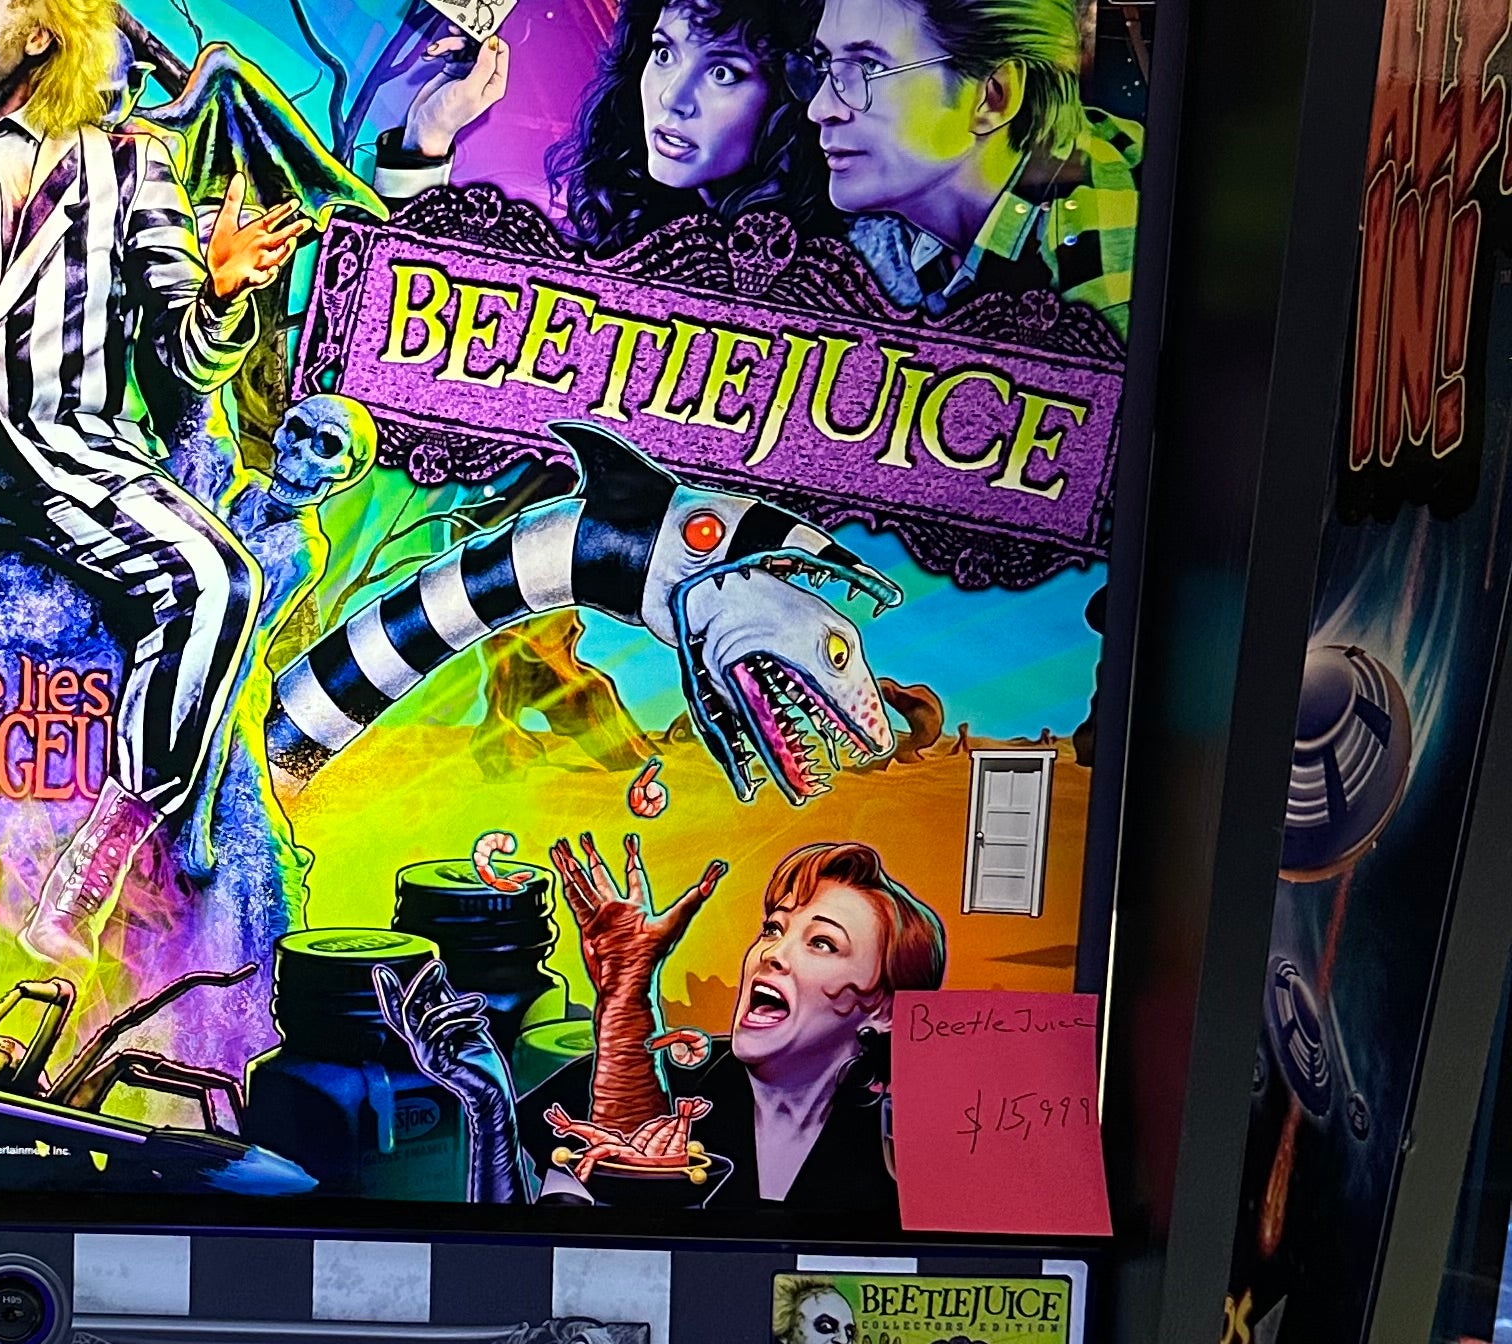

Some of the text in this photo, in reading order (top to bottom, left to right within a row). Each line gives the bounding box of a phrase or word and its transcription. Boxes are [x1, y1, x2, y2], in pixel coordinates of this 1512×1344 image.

[1349, 160, 1481, 472] IN!
[380, 264, 1087, 500] BEETLEJUICE
[18, 655, 112, 715] lies
[52, 1145, 71, 1156] Inc.
[860, 1283, 1063, 1326] BEETLEJUICE
[861, 1320, 1059, 1333] COLLECTORS EDITION
